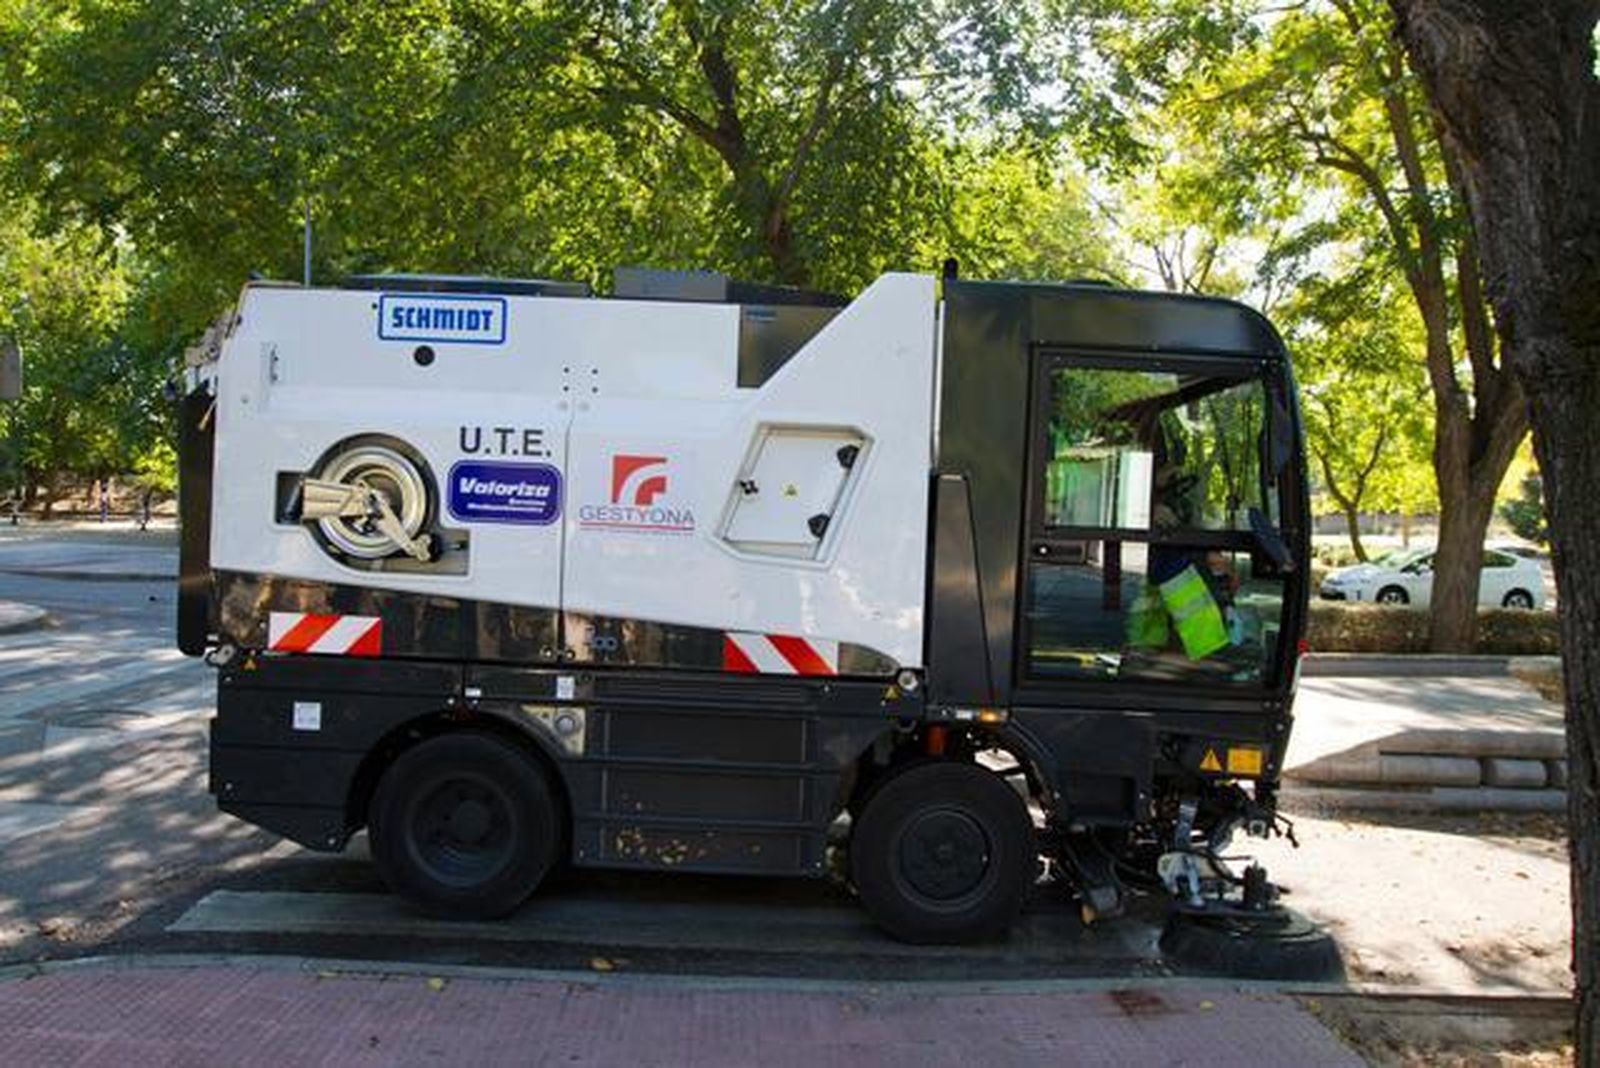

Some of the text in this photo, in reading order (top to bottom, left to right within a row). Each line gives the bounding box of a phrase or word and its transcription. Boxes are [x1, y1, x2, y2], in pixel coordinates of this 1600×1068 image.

[392, 306, 493, 331] SCHMIDT
[459, 426, 552, 457] U.T.E.
[459, 477, 550, 497] Valoriza
[579, 505, 695, 524] GESTYONA
